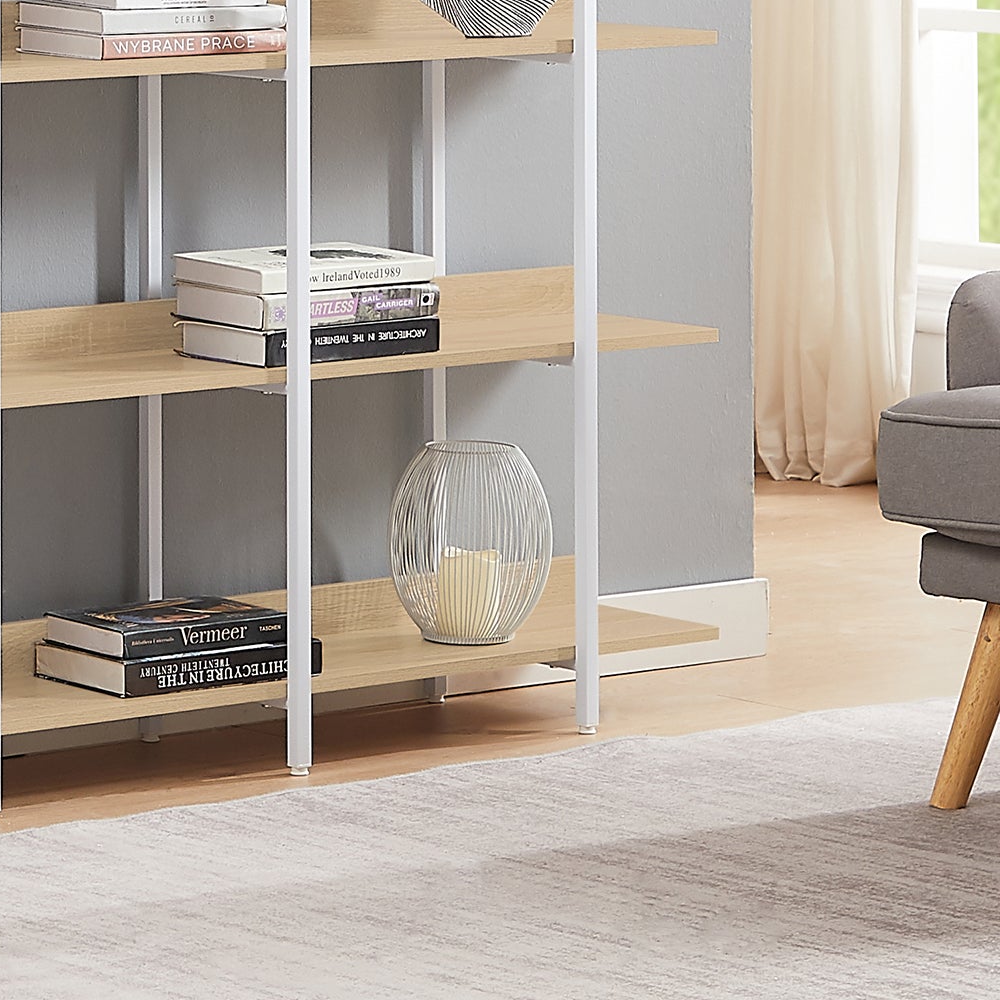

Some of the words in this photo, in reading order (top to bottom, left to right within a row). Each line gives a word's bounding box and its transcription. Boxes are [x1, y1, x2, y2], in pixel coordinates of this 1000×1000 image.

[174, 15, 207, 24] CEREAL
[112, 36, 195, 54] WYBRANE
[201, 35, 256, 50] PRACE
[361, 295, 380, 303] GAIL
[352, 333, 365, 343] THE
[179, 624, 248, 646] Vermeer
[140, 666, 179, 678] CENTURY
[157, 673, 187, 689] THE
[189, 672, 205, 685] IN
